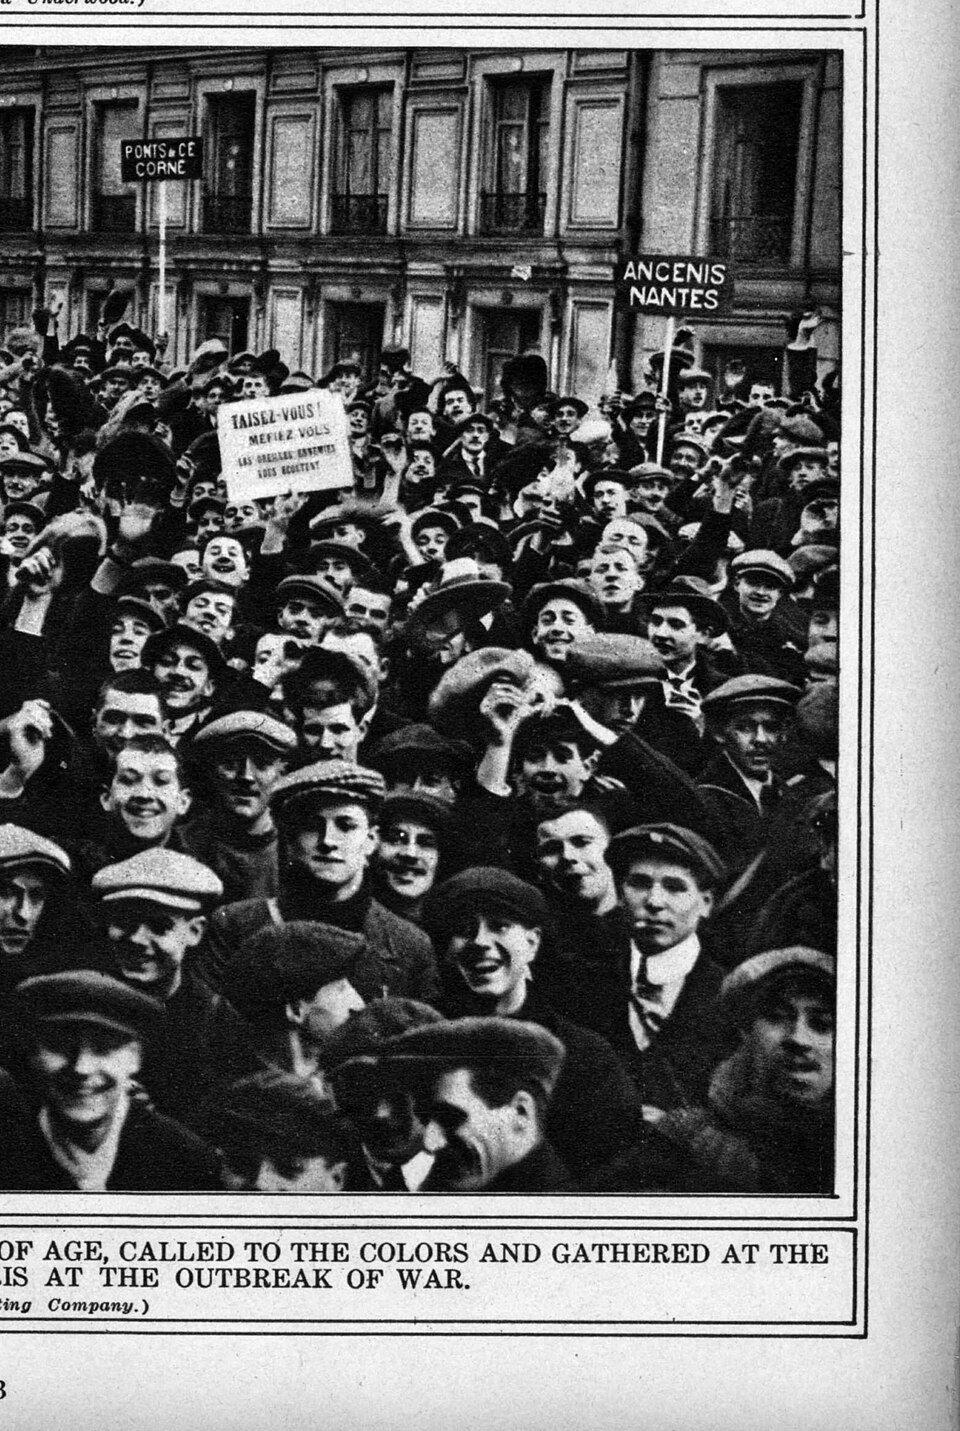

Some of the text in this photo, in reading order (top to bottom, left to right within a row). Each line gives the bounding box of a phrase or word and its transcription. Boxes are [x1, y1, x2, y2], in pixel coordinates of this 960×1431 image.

[125, 142, 167, 159] PONTS
[623, 261, 726, 285] ANCENIS
[630, 286, 719, 309] NANTES
[42, 1240, 109, 1266] AGE,
[119, 1240, 235, 1262] CALLED
[243, 1241, 282, 1263] TO
[290, 1241, 350, 1263] THE
[359, 1241, 469, 1264] COLORS
[478, 1242, 542, 1264] AND
[551, 1242, 711, 1264] GATHERED
[720, 1243, 760, 1265] AT
[769, 1243, 829, 1265] THE
[44, 1266, 84, 1288] AT
[98, 1266, 159, 1288] THE
[175, 1267, 333, 1289] OUTBREAK
[346, 1268, 384, 1290] OF
[395, 1268, 471, 1290] WAR.
[47, 1297, 150, 1316] Company.)
